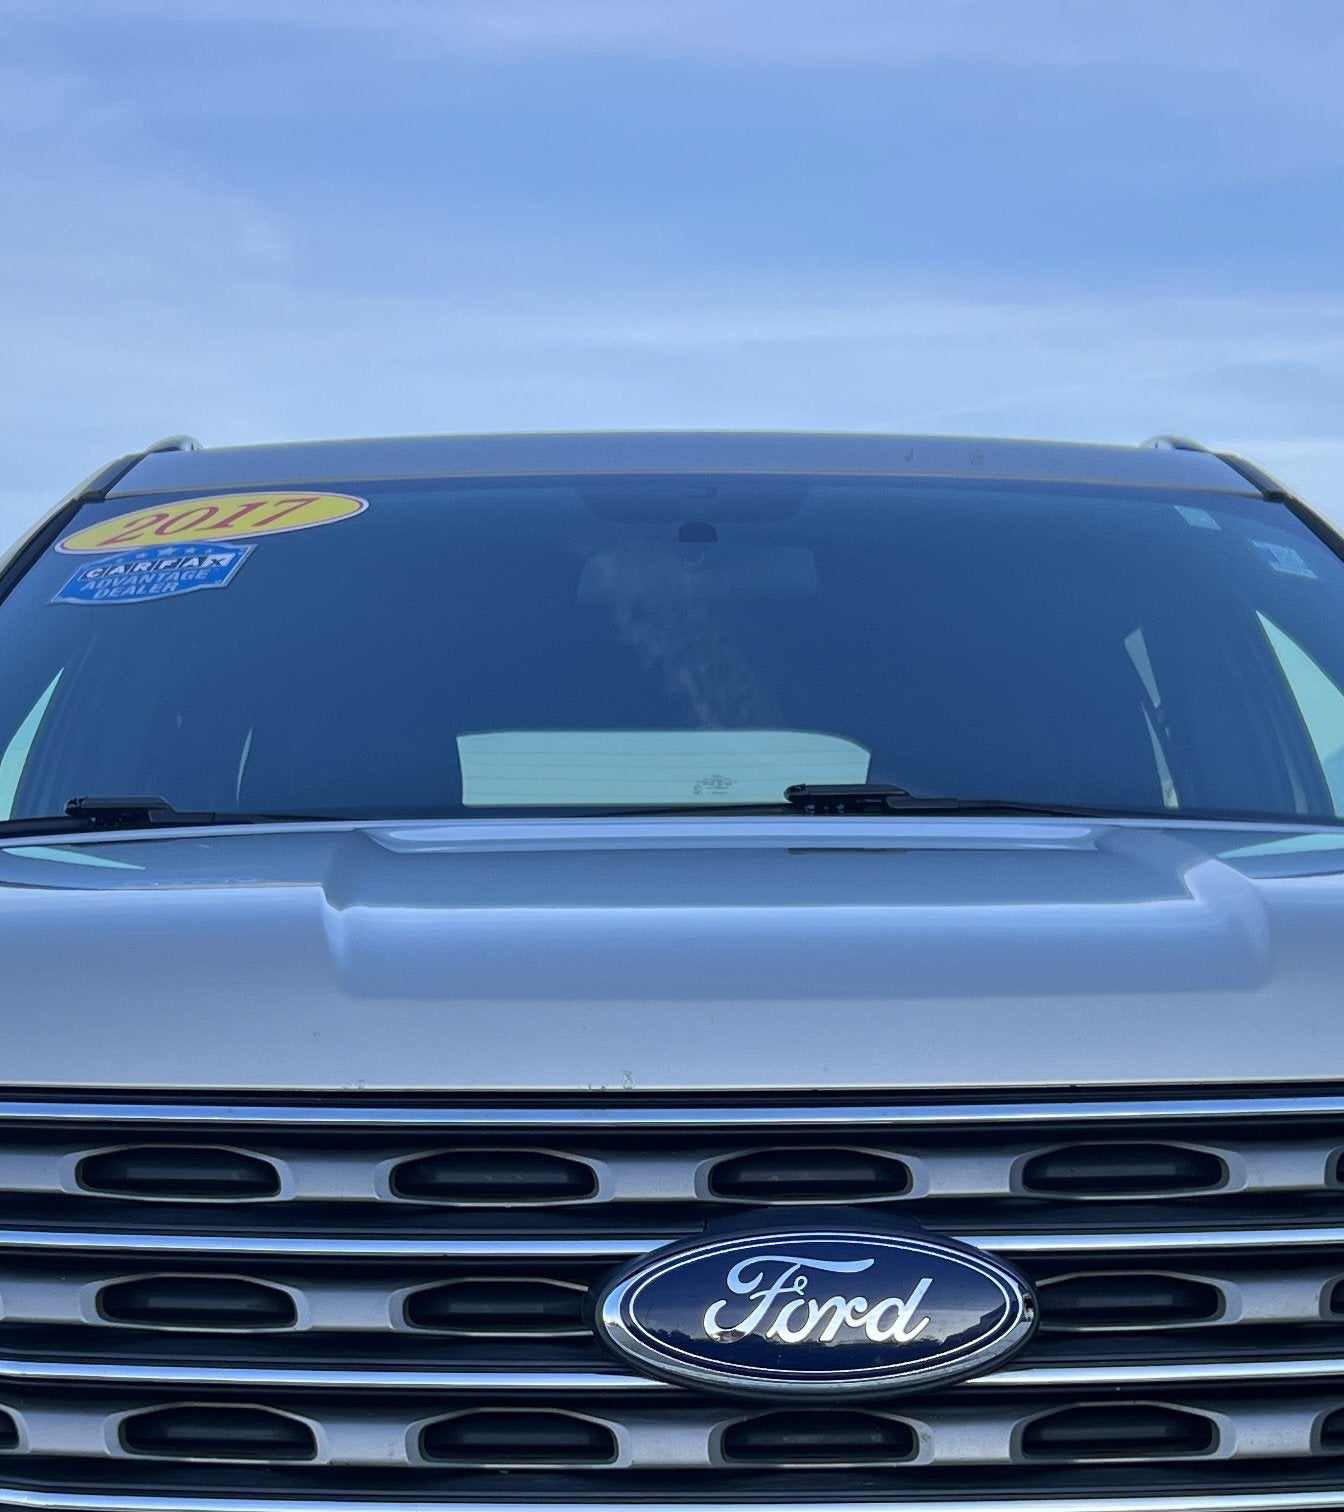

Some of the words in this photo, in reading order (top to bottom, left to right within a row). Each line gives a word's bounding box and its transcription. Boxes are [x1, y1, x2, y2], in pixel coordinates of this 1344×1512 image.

[96, 496, 322, 547] 2017
[84, 555, 231, 579] CARFAX
[80, 568, 210, 592] ADVANTAGE
[93, 581, 180, 599] DEALER
[703, 1255, 933, 1344] Ford
